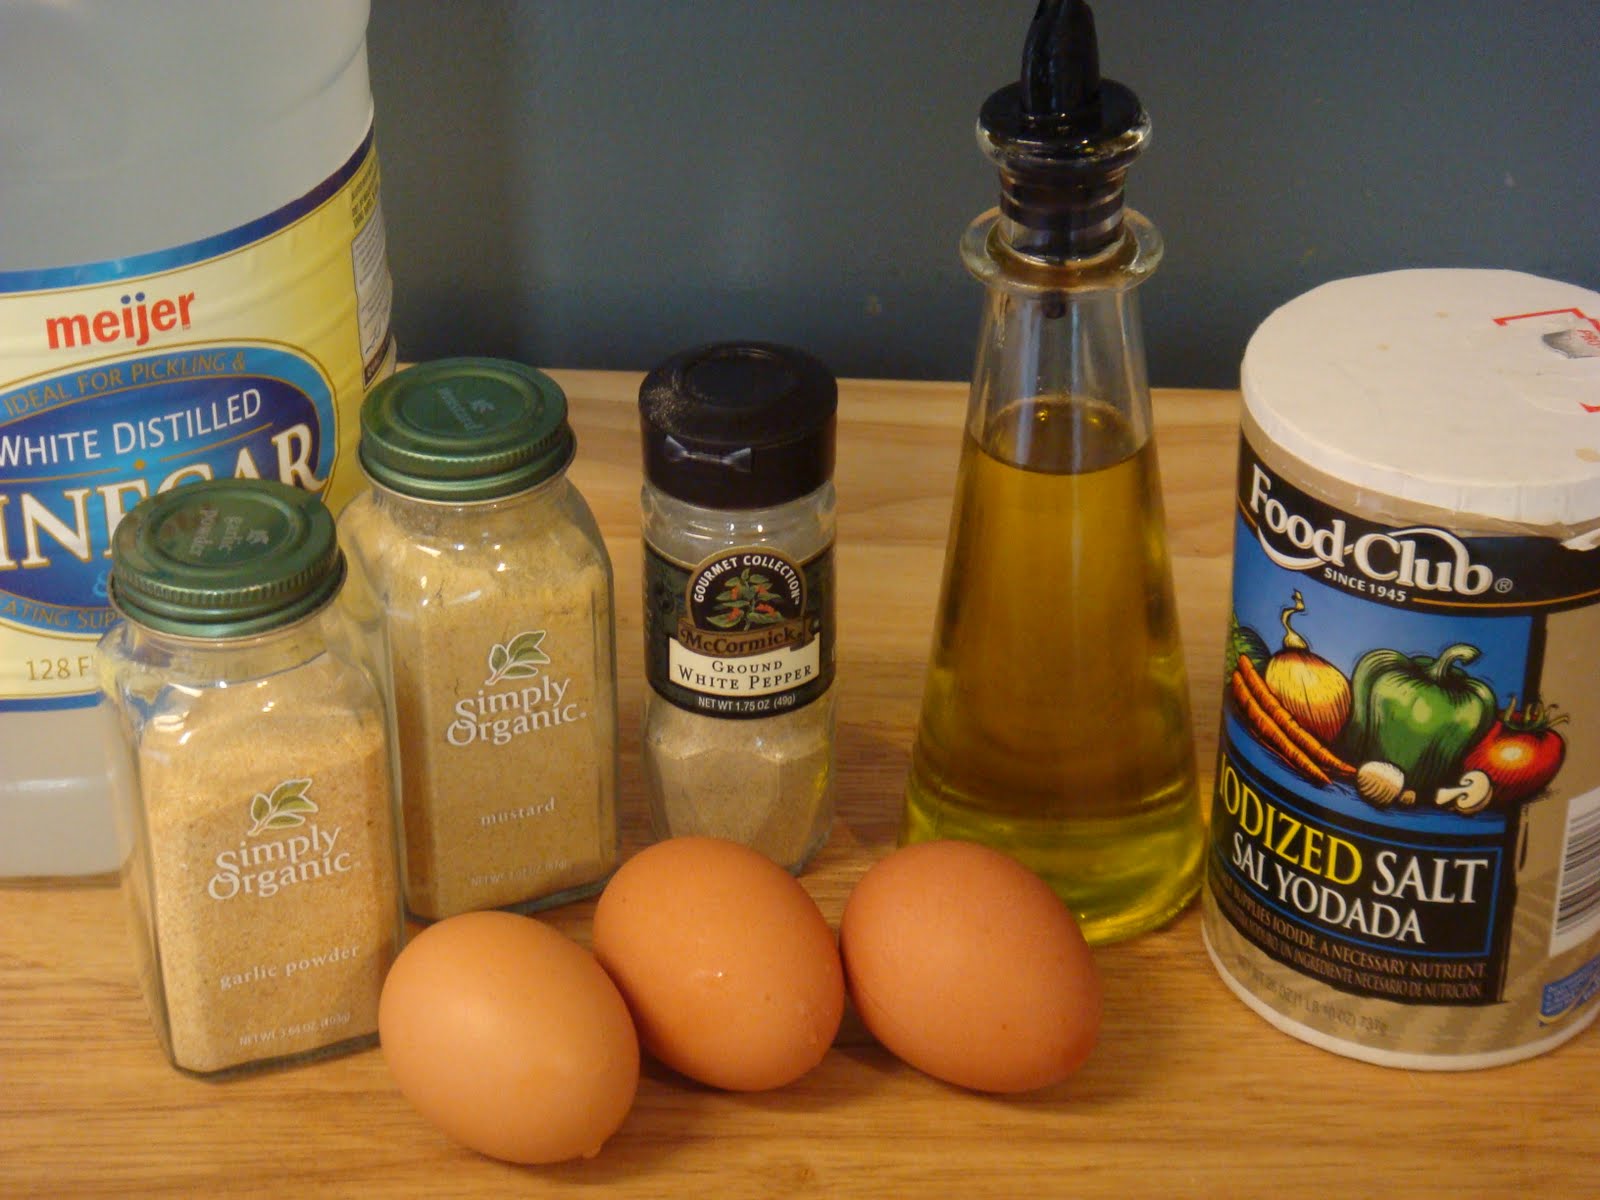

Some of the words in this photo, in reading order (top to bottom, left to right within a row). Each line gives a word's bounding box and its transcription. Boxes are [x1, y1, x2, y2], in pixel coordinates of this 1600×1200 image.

[46, 291, 195, 350] meijer
[4, 383, 71, 417] IDEAL
[78, 368, 123, 395] FOR
[132, 351, 226, 383] PICKLING
[232, 351, 245, 372] &
[0, 429, 101, 467] WHITE
[112, 388, 262, 456] DISTILLED
[693, 556, 739, 603] GOURMET
[743, 555, 800, 600] COLLECTION
[1323, 566, 1366, 593] SINCE
[1369, 583, 1407, 602] 1945
[680, 626, 797, 656] McCormick
[26, 657, 70, 681] 128
[77, 655, 93, 677] F
[678, 664, 740, 690] WHITE
[749, 664, 812, 691] PEPPER
[712, 659, 783, 675] GROUND
[455, 675, 571, 723] Simply
[698, 696, 716, 709] NET
[718, 699, 733, 712] WT
[757, 699, 770, 710] OZ
[480, 796, 556, 827] mustard
[1219, 752, 1363, 885] IODIZED
[1372, 851, 1489, 903] SALT
[215, 823, 342, 876] Simply
[1232, 831, 1270, 891] SAL
[1274, 862, 1426, 945] YODADA
[219, 965, 278, 991] garlic
[285, 944, 361, 977] powder
[1320, 940, 1329, 957] A
[1330, 943, 1409, 976] NECESSARY
